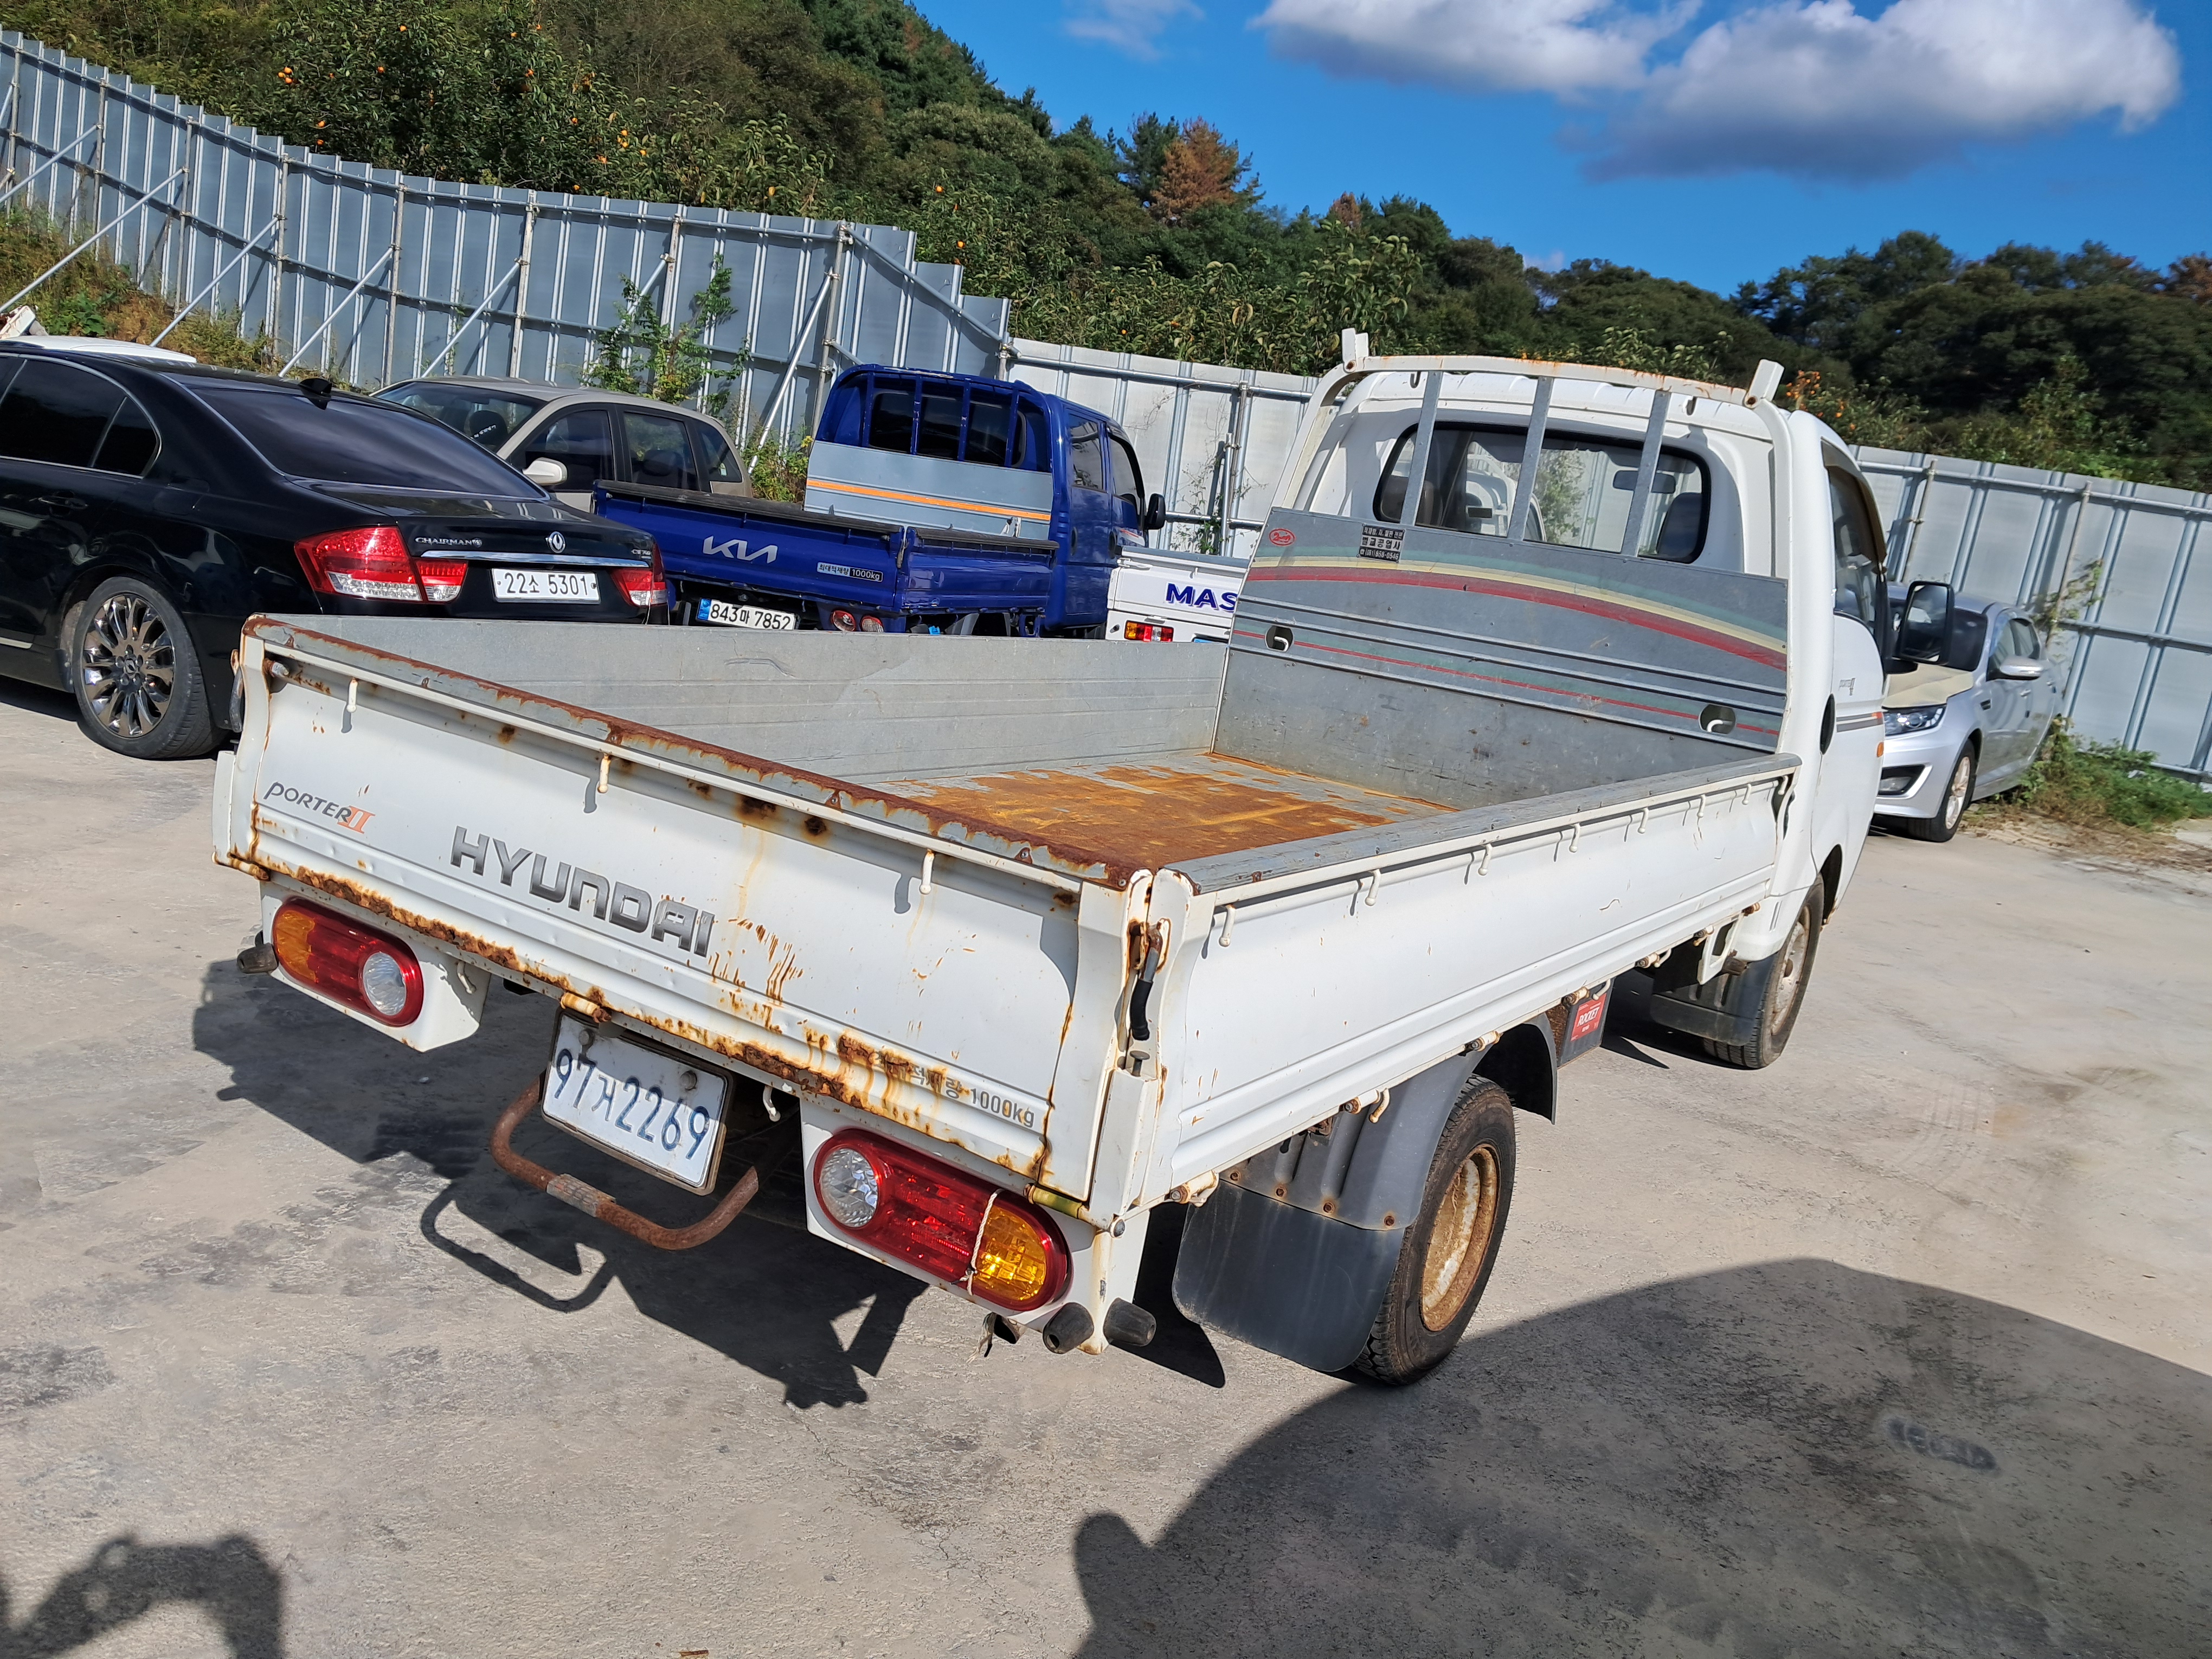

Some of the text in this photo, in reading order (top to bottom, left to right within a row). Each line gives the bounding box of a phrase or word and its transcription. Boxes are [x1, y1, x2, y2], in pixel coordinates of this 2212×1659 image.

[415, 537, 472, 545] CHAIRMAN
[504, 573, 588, 596] 22소 5301
[818, 563, 880, 581] 최대적재량 1000kg
[710, 603, 791, 630] 843마 7852
[262, 781, 352, 824] PORTER
[450, 825, 716, 957] HYUNDAI
[1577, 1006, 1600, 1027] ROCKET
[970, 1087, 1035, 1128] 1000kg
